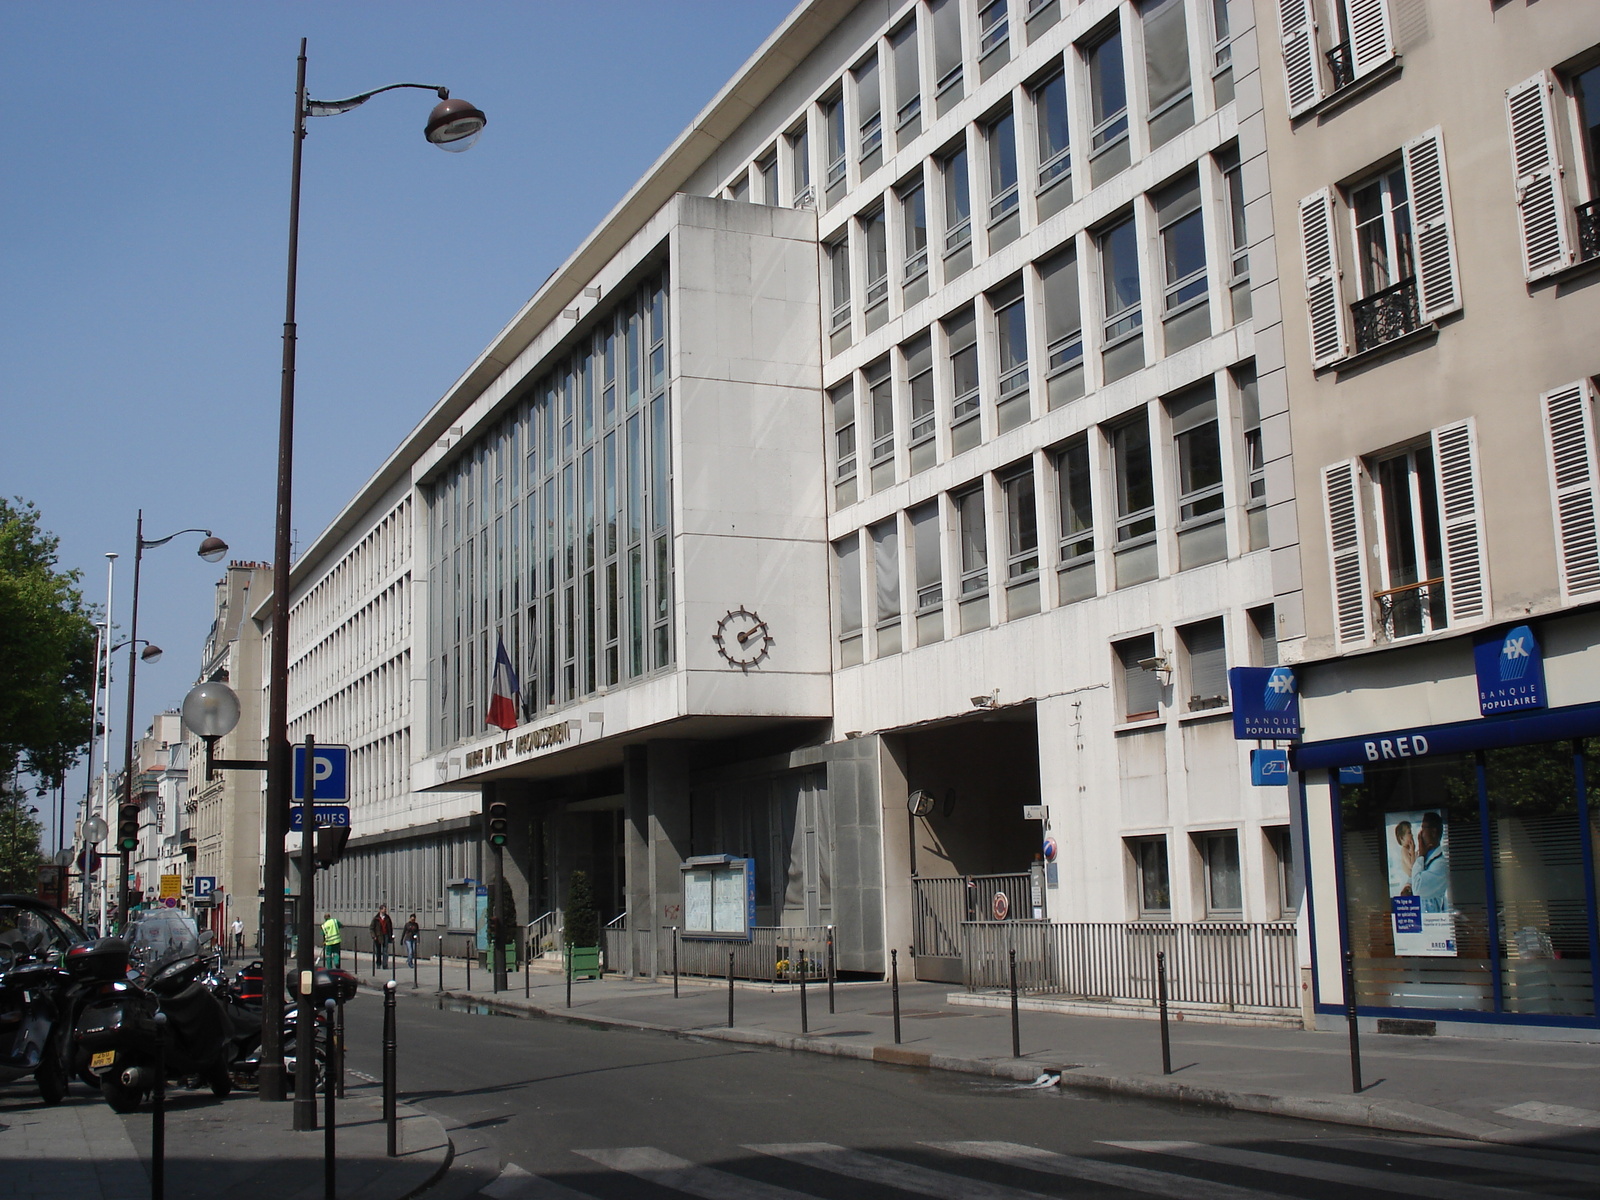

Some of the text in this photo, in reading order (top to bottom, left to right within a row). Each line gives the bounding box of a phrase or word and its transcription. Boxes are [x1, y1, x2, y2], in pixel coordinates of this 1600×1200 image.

[1481, 684, 1536, 700] BANQUE
[1482, 695, 1537, 711] POPULAIRE
[1245, 717, 1297, 725] BANQUE
[1246, 727, 1297, 735] POPULAIRE
[1364, 735, 1429, 761] BRED
[313, 756, 333, 790] P
[200, 879, 211, 894] P
